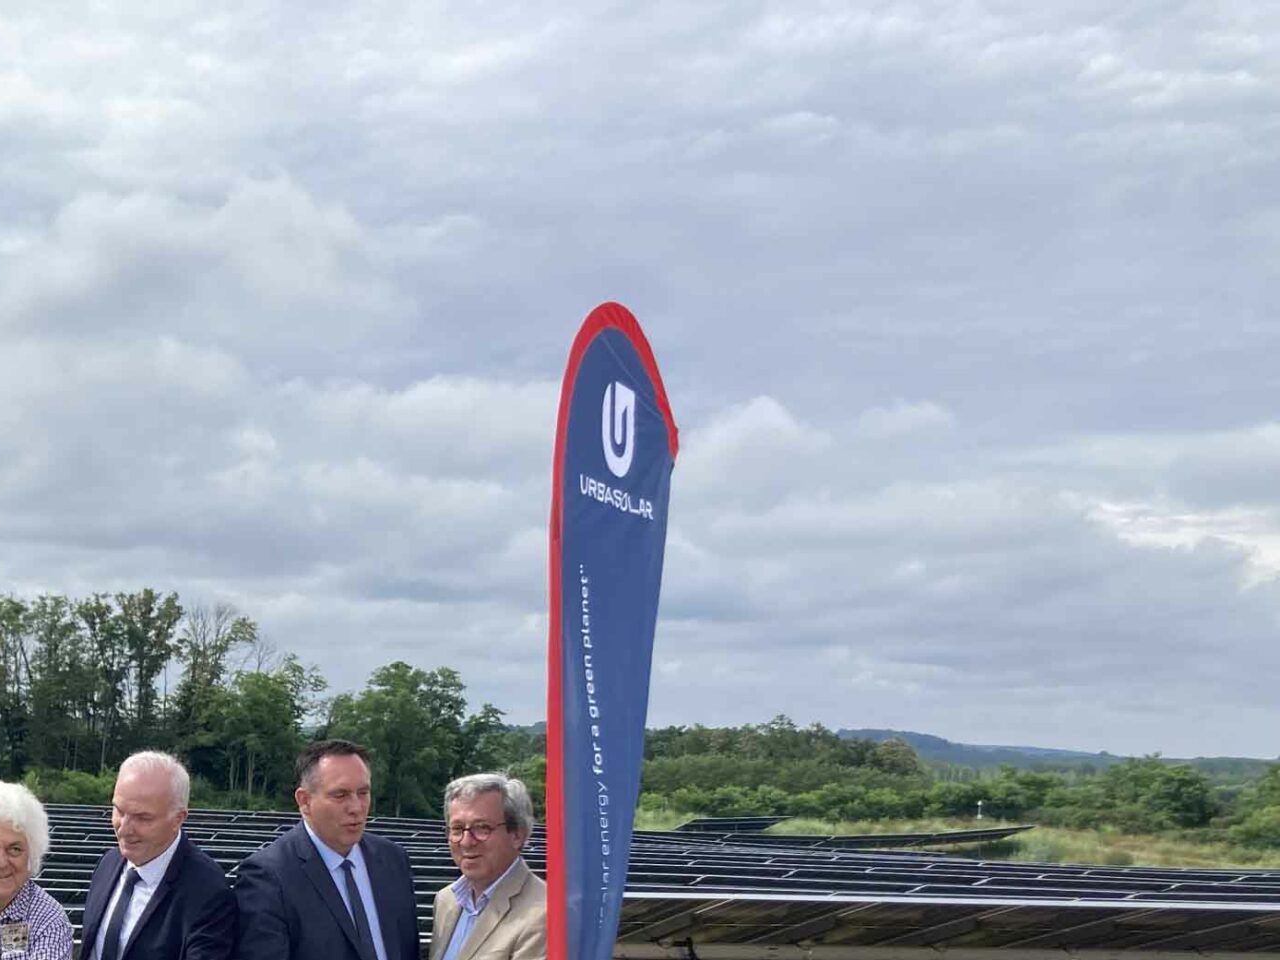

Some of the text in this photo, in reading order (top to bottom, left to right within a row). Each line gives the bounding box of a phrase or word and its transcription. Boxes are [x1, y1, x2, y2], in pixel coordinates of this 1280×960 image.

[579, 473, 654, 520] URBASOLAR
[583, 655, 600, 718] green
[591, 725, 600, 737] a
[592, 742, 604, 775] for
[597, 781, 611, 856] energy
